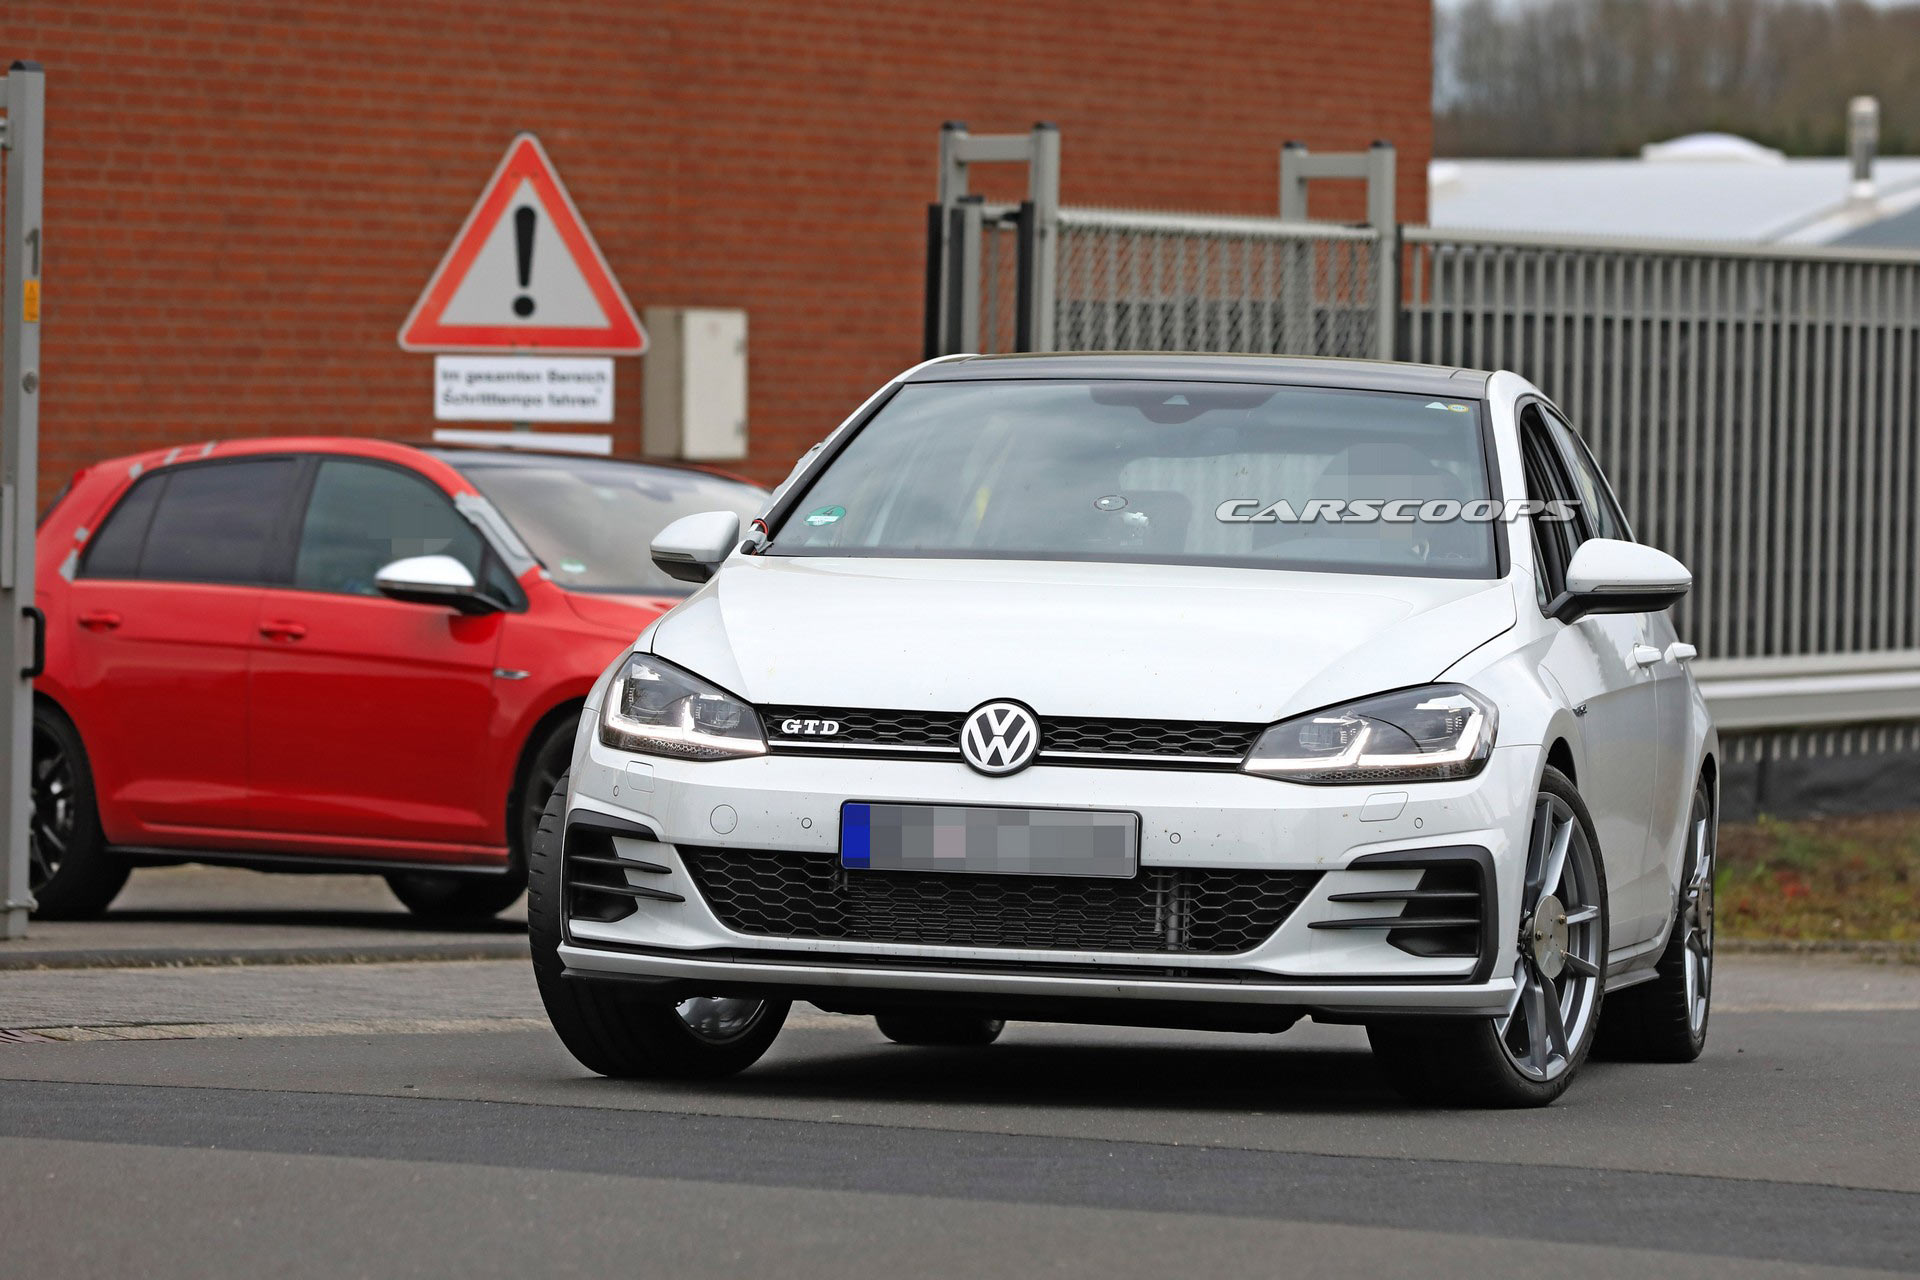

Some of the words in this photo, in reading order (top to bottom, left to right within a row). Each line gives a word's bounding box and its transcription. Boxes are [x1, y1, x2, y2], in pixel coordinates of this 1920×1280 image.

[547, 370, 605, 383] Bereich
[548, 392, 598, 406] fahren
[781, 719, 839, 735] GTD
[961, 702, 1039, 775] VW
